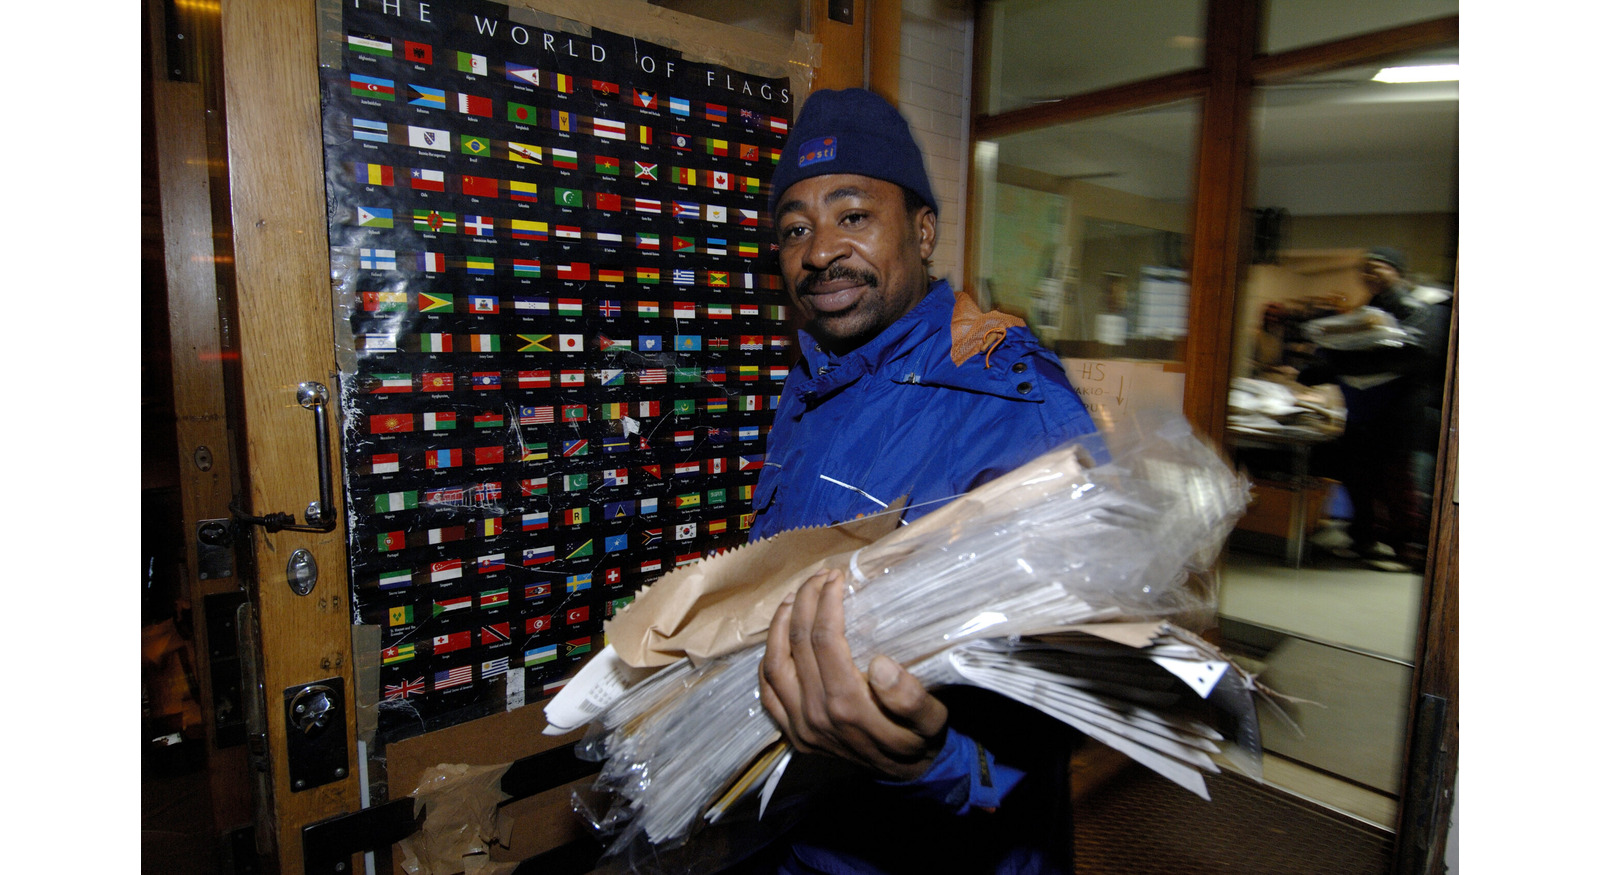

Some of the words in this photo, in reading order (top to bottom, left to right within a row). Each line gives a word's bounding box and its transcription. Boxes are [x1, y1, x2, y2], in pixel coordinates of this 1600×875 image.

[474, 15, 606, 62] WORLD
[640, 56, 675, 78] OF
[707, 71, 789, 103] FLAGS
[1079, 363, 1106, 381] HS
[1074, 387, 1110, 396] AKIO-
